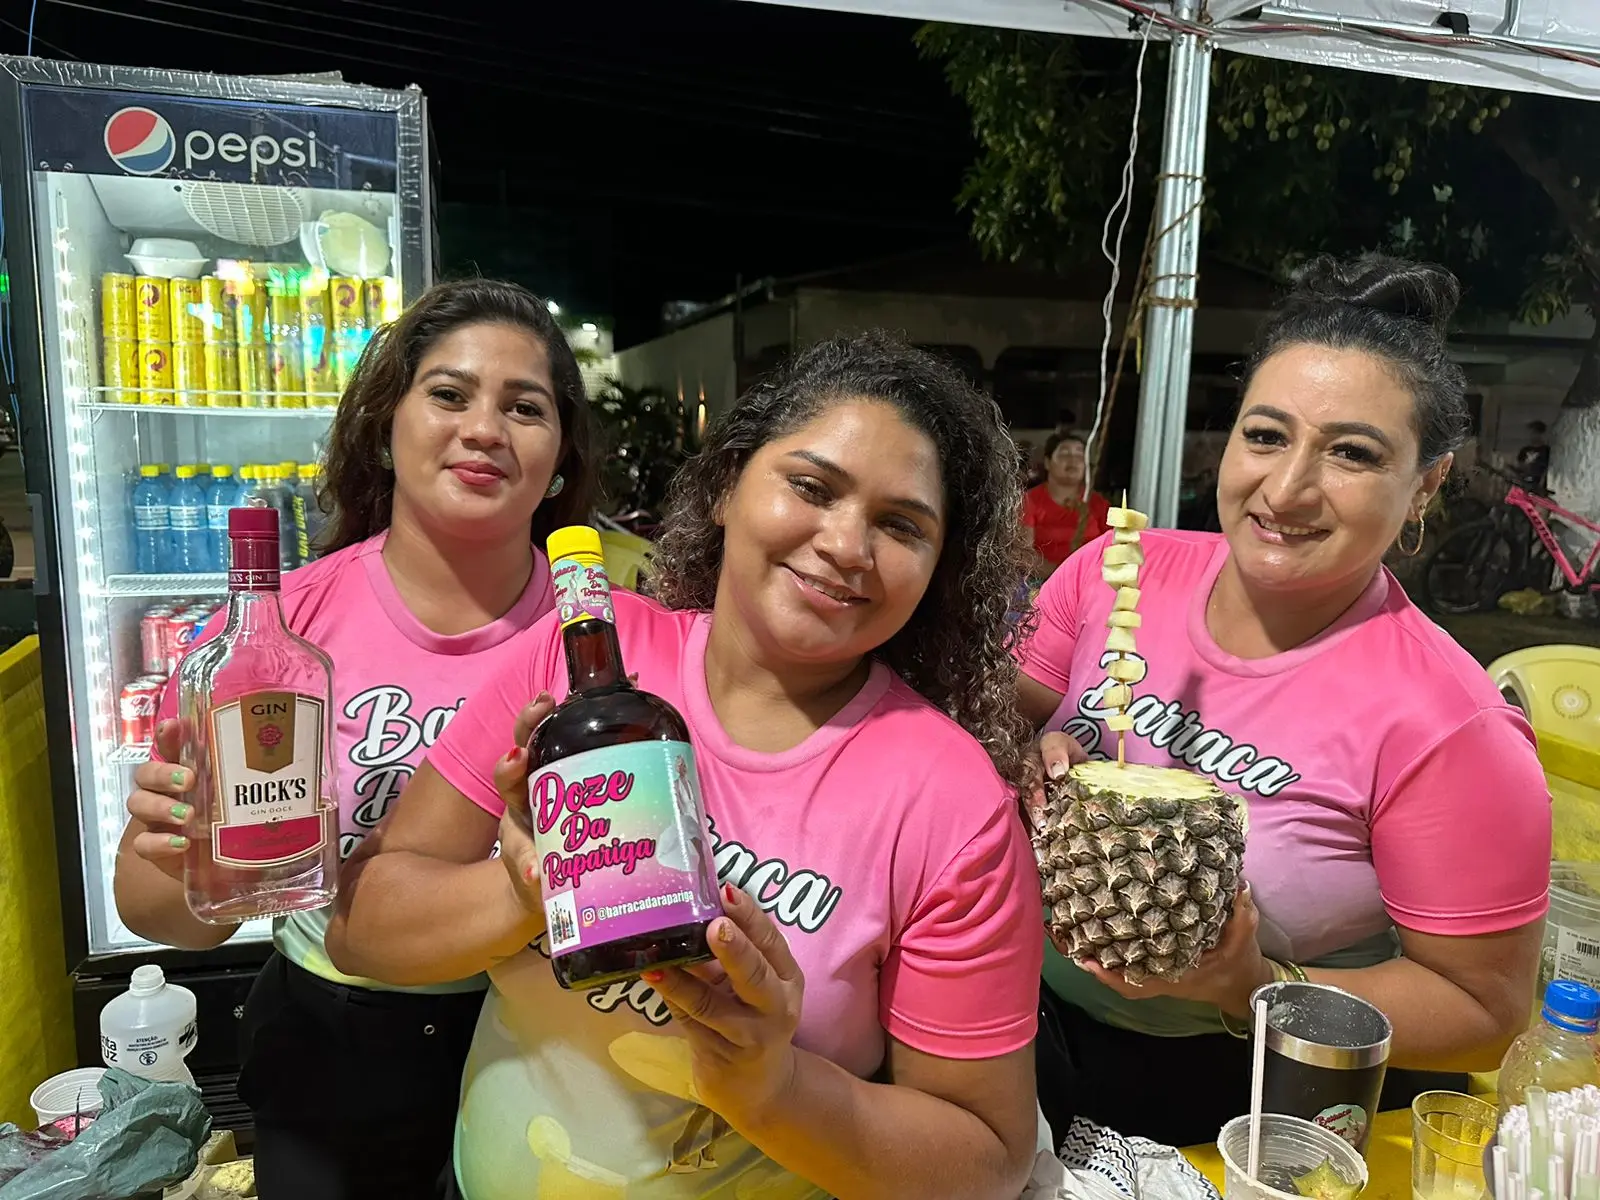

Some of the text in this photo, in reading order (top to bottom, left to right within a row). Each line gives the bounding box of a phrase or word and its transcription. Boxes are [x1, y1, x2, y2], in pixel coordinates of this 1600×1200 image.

[184, 130, 318, 174] pepsi
[251, 702, 288, 716] GIN
[234, 777, 307, 807] ROCK'S
[532, 769, 635, 835] Doze
[250, 805, 293, 816] GIN DOCE
[560, 812, 611, 853] Da
[543, 838, 656, 890] Rapariga
[597, 889, 694, 921] @barracadarapariga
